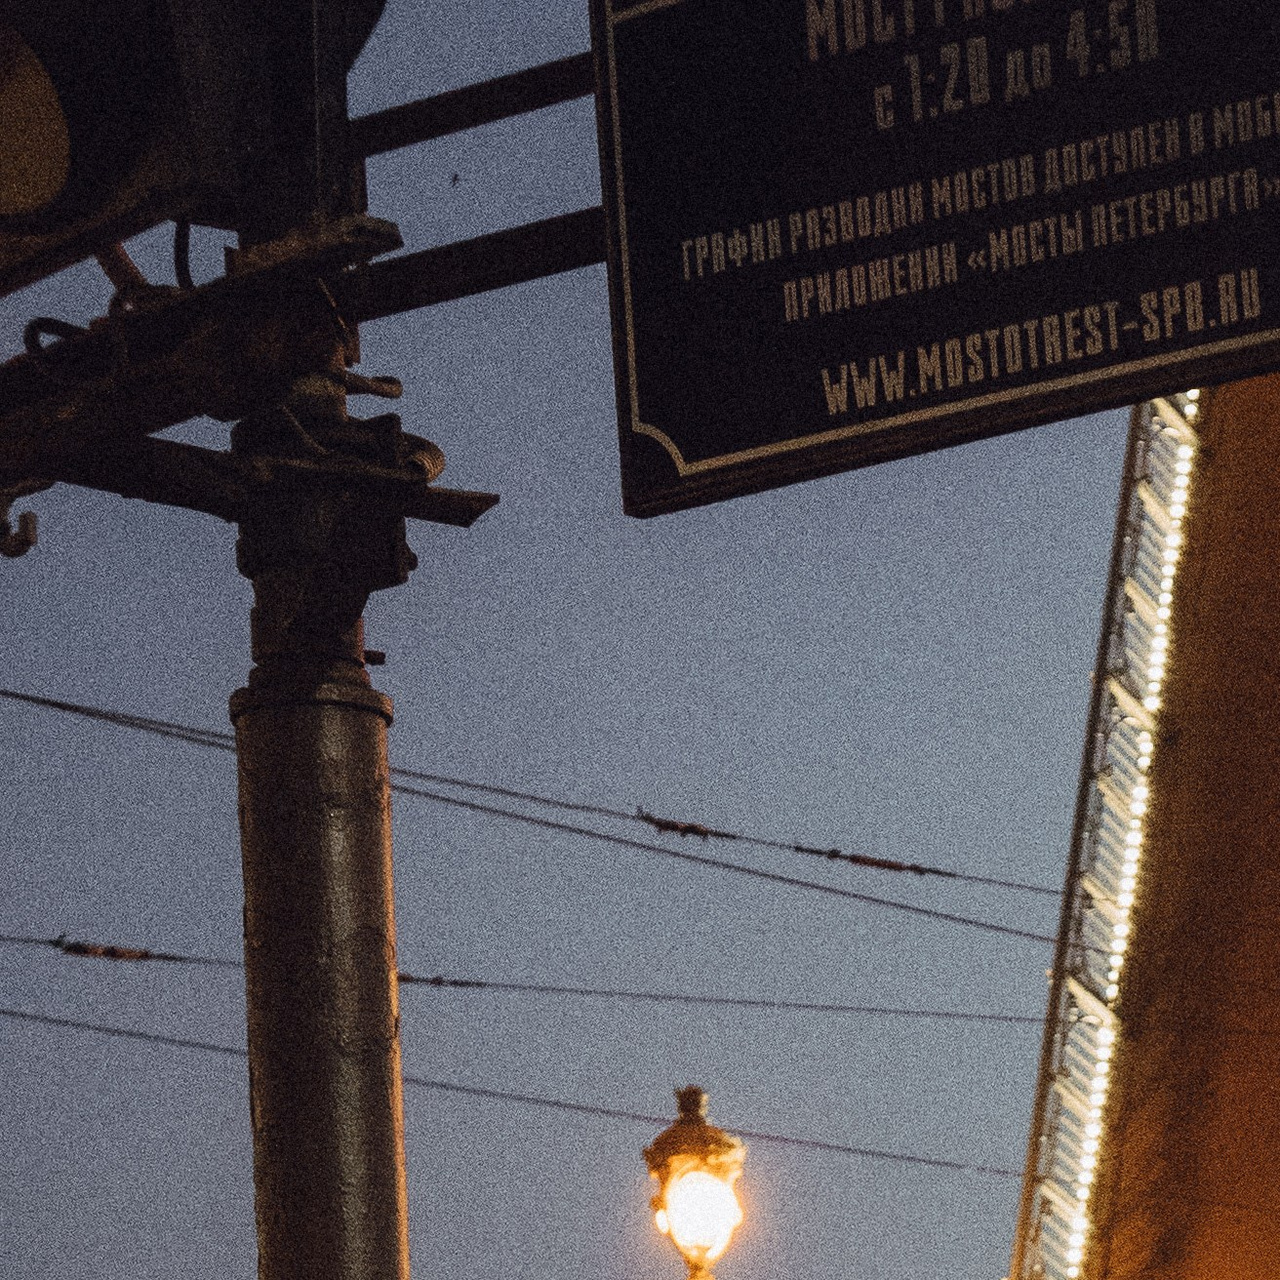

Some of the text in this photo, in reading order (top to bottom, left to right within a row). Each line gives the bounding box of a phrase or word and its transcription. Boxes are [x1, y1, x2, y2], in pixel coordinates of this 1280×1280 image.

[904, 36, 990, 122] 1:20
[1004, 43, 1053, 102] до
[1067, 0, 1159, 77] 4:50
[931, 154, 1036, 220] МОСТОВ
[1043, 119, 1181, 194] ДОСТУПЕН
[1188, 112, 1206, 155] В
[782, 241, 959, 323] ПРИЛОЖЕНИИ
[966, 208, 1083, 273] «МОСТЫ
[820, 268, 1263, 415] WWW.MOSTOTREST-SPB.RU
